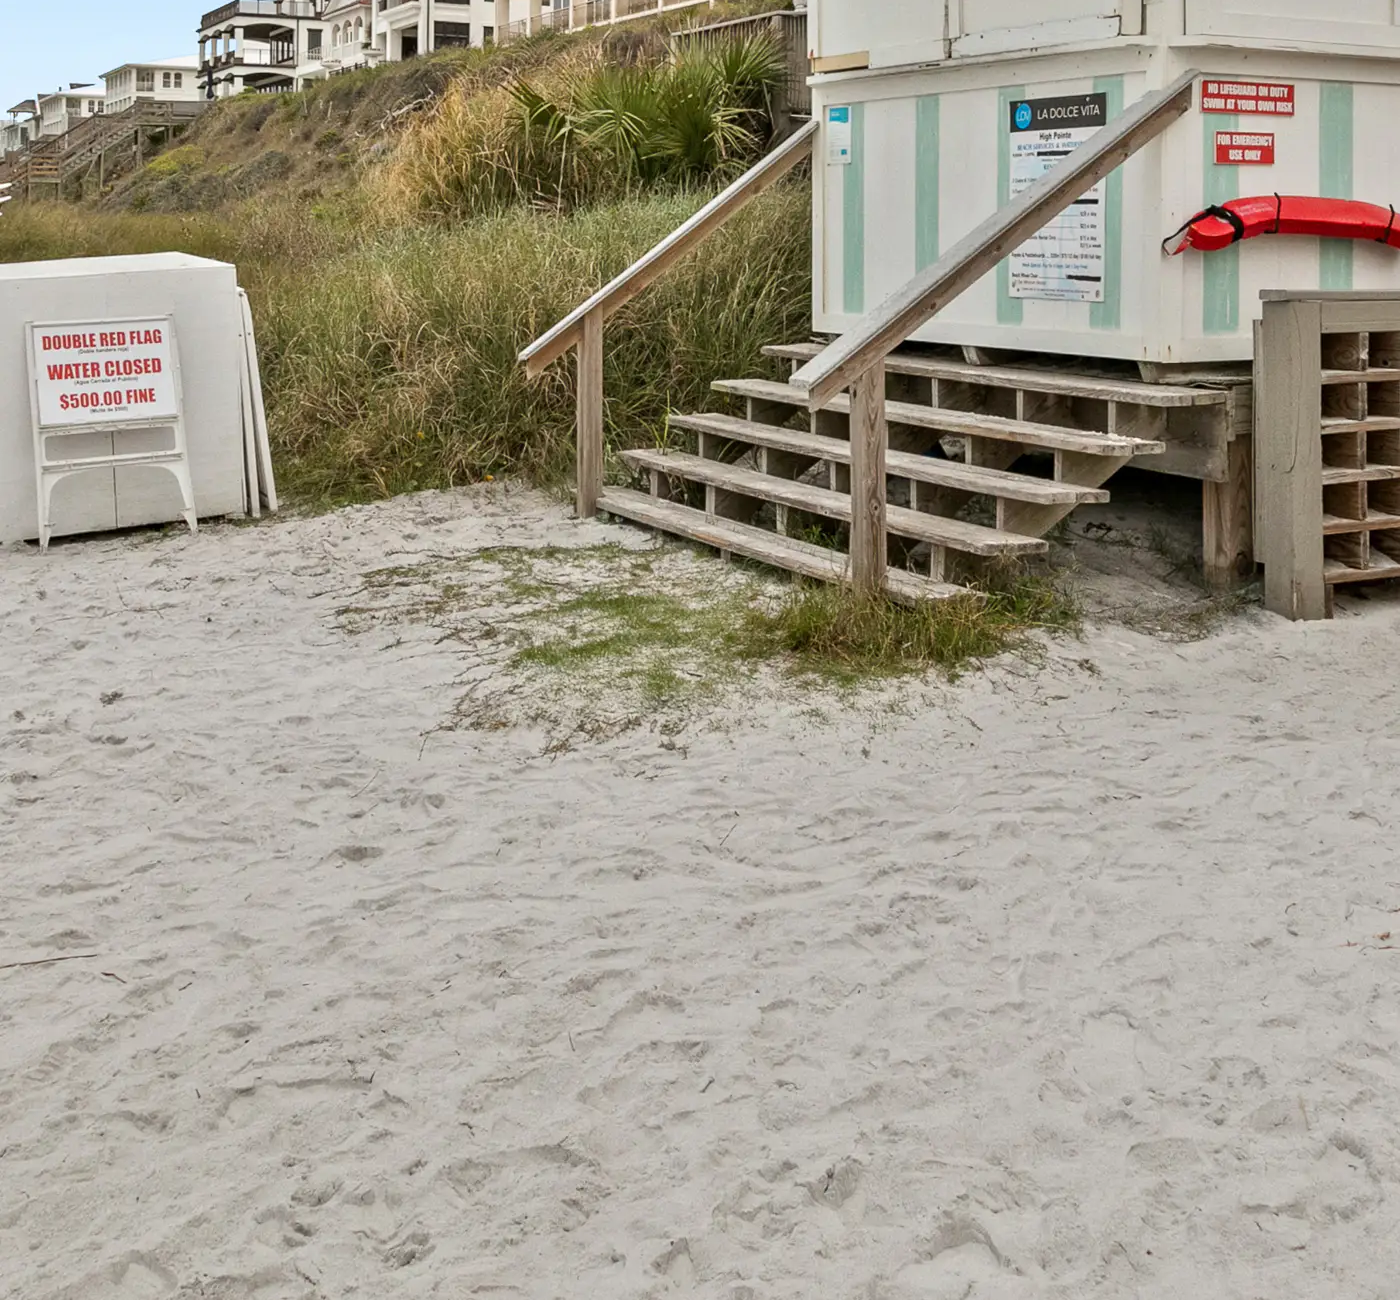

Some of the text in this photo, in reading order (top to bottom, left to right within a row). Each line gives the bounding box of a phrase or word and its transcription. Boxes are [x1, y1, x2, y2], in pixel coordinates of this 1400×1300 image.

[1208, 83, 1288, 98] NO LIFEGUARD ON DUTY
[1037, 104, 1100, 120] LA DOLCE VITA
[1203, 98, 1293, 112] SWIM AT YOUR OWN RISK
[1039, 132, 1072, 142] High Pointe
[1217, 134, 1273, 146] FOR EMERGENCY
[1229, 149, 1261, 161] USE ONLY
[42, 329, 162, 350] DOUBLE RED FLAG
[47, 358, 162, 380] WATER CLOSED
[59, 388, 156, 410] $500.00 FINE
